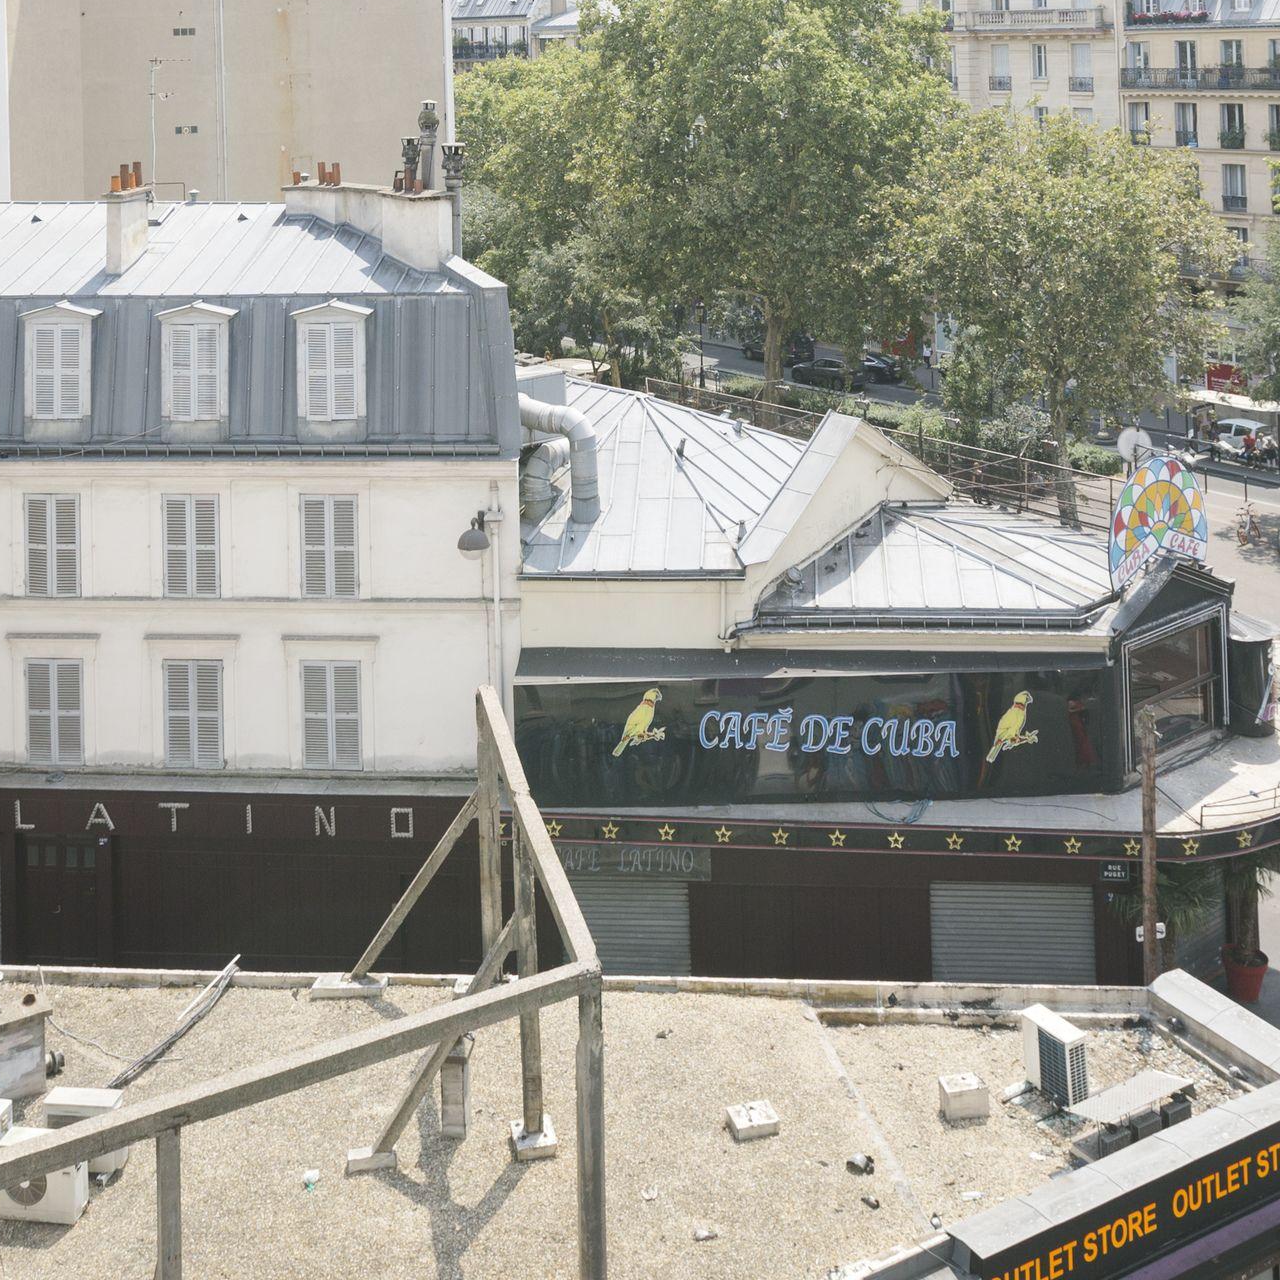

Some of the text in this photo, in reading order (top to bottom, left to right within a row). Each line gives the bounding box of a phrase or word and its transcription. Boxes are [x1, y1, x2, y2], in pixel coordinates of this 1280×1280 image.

[1118, 543, 1150, 584] CUBA
[800, 714, 854, 755] DE
[861, 716, 960, 758] CUBA
[556, 847, 695, 873] AFE LATINO
[1083, 1203, 1158, 1263] STORE
[1172, 1158, 1251, 1219] OUTLET
